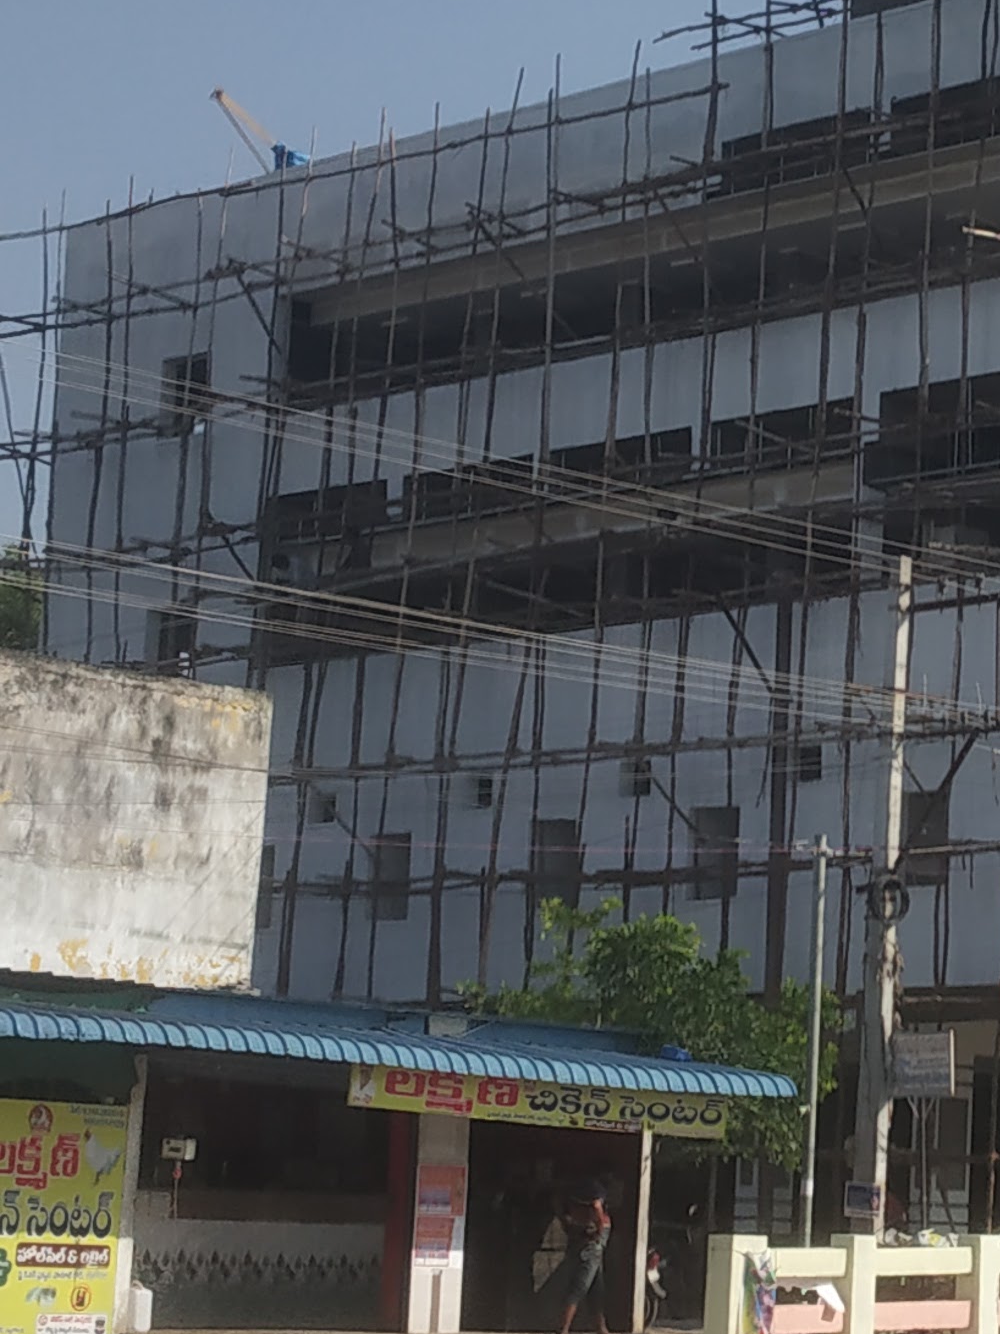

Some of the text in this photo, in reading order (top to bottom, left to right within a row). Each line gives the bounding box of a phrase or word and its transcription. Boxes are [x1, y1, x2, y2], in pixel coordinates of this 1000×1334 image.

[525, 1085, 611, 1117] చికెన్
[618, 1094, 726, 1126] సెంటర్
[26, 1192, 114, 1238] సెంటర్
